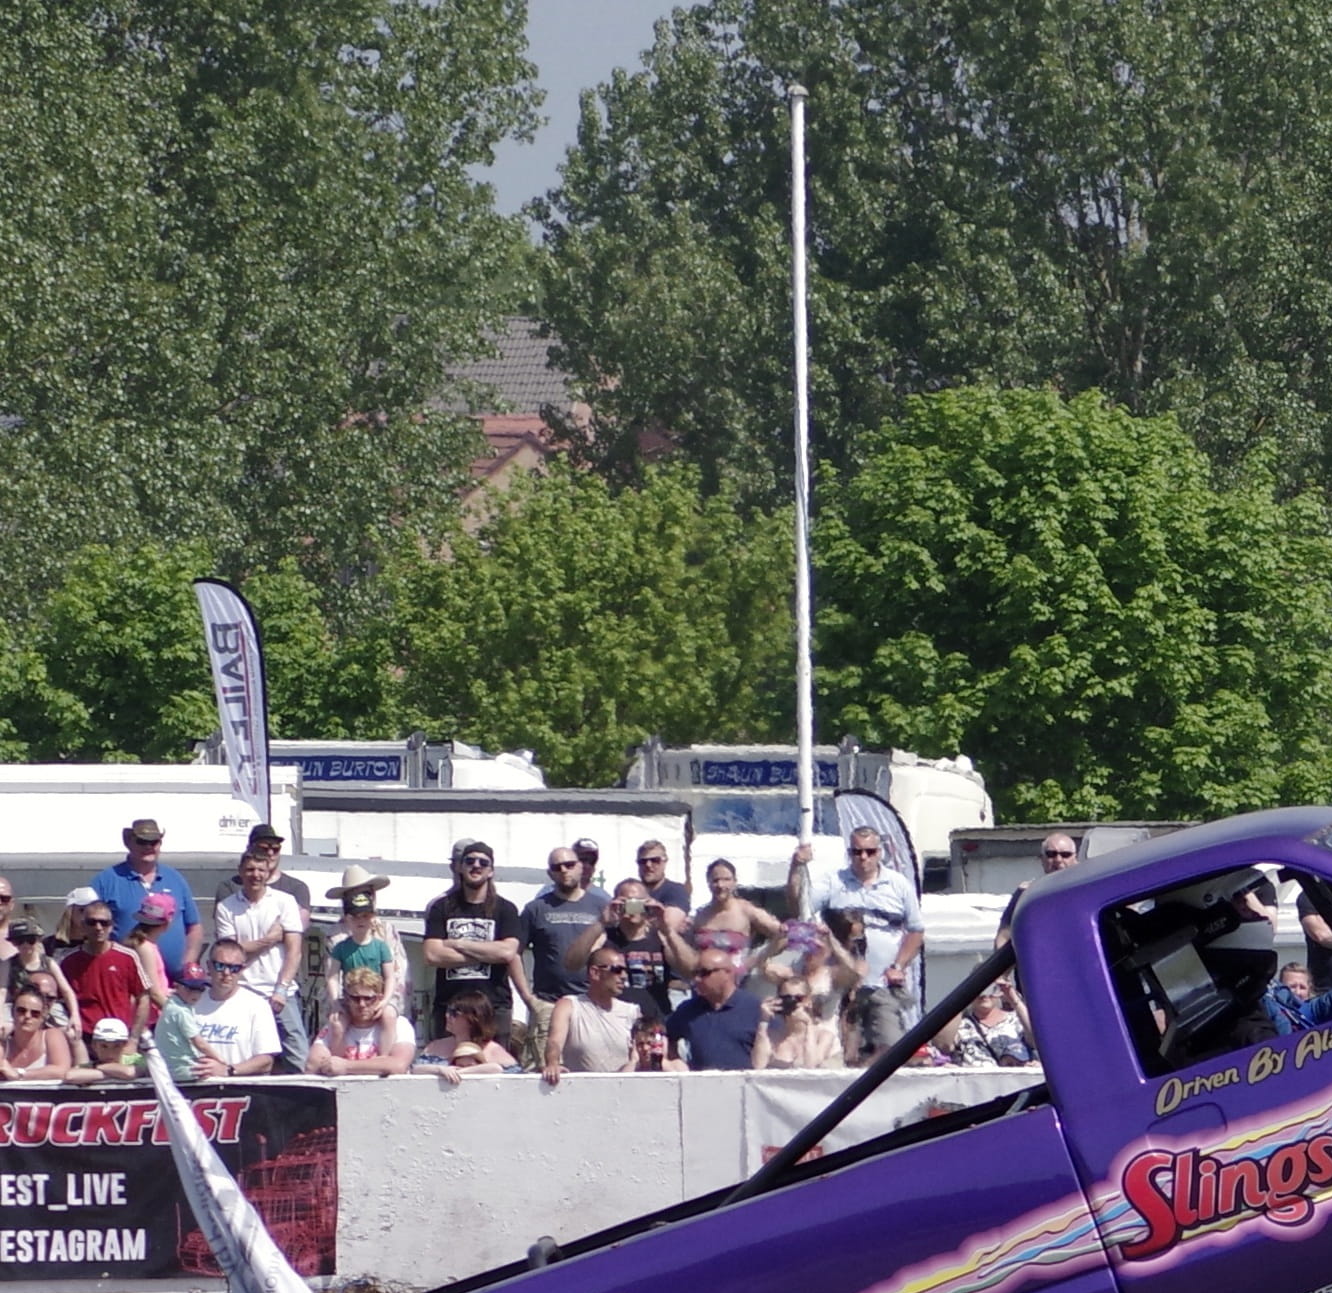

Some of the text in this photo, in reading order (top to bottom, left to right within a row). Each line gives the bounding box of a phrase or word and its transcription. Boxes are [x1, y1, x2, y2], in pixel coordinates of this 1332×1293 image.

[329, 760, 399, 777] BURTON
[1155, 1066, 1240, 1116] Driven
[1247, 1046, 1287, 1085] By
